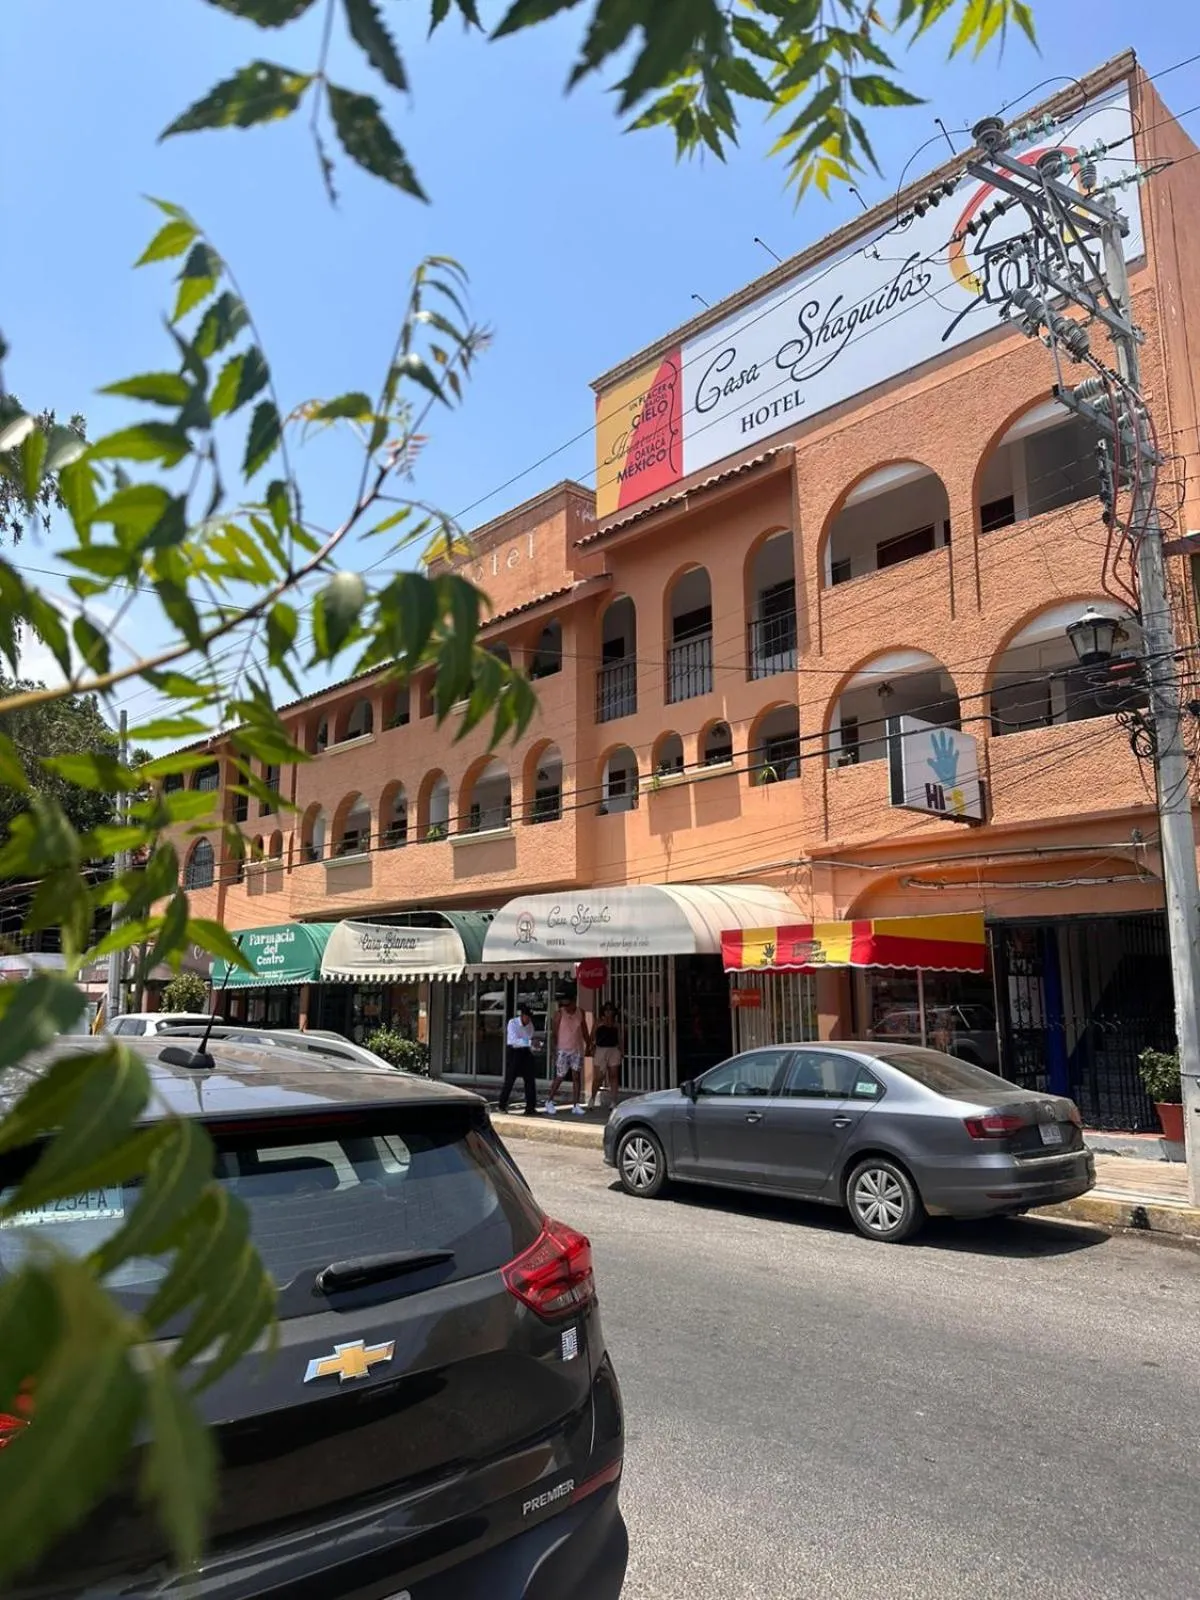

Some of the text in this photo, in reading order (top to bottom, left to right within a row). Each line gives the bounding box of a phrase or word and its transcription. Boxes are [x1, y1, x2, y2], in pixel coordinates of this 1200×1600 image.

[695, 348, 760, 413] Casa
[631, 400, 668, 428] CIELO
[741, 389, 806, 433] HOTEL
[249, 928, 295, 946] Farmacia
[263, 942, 278, 955] del
[361, 932, 381, 951] Casa
[256, 953, 285, 966] Centro
[523, 1478, 575, 1515] PREMIER
